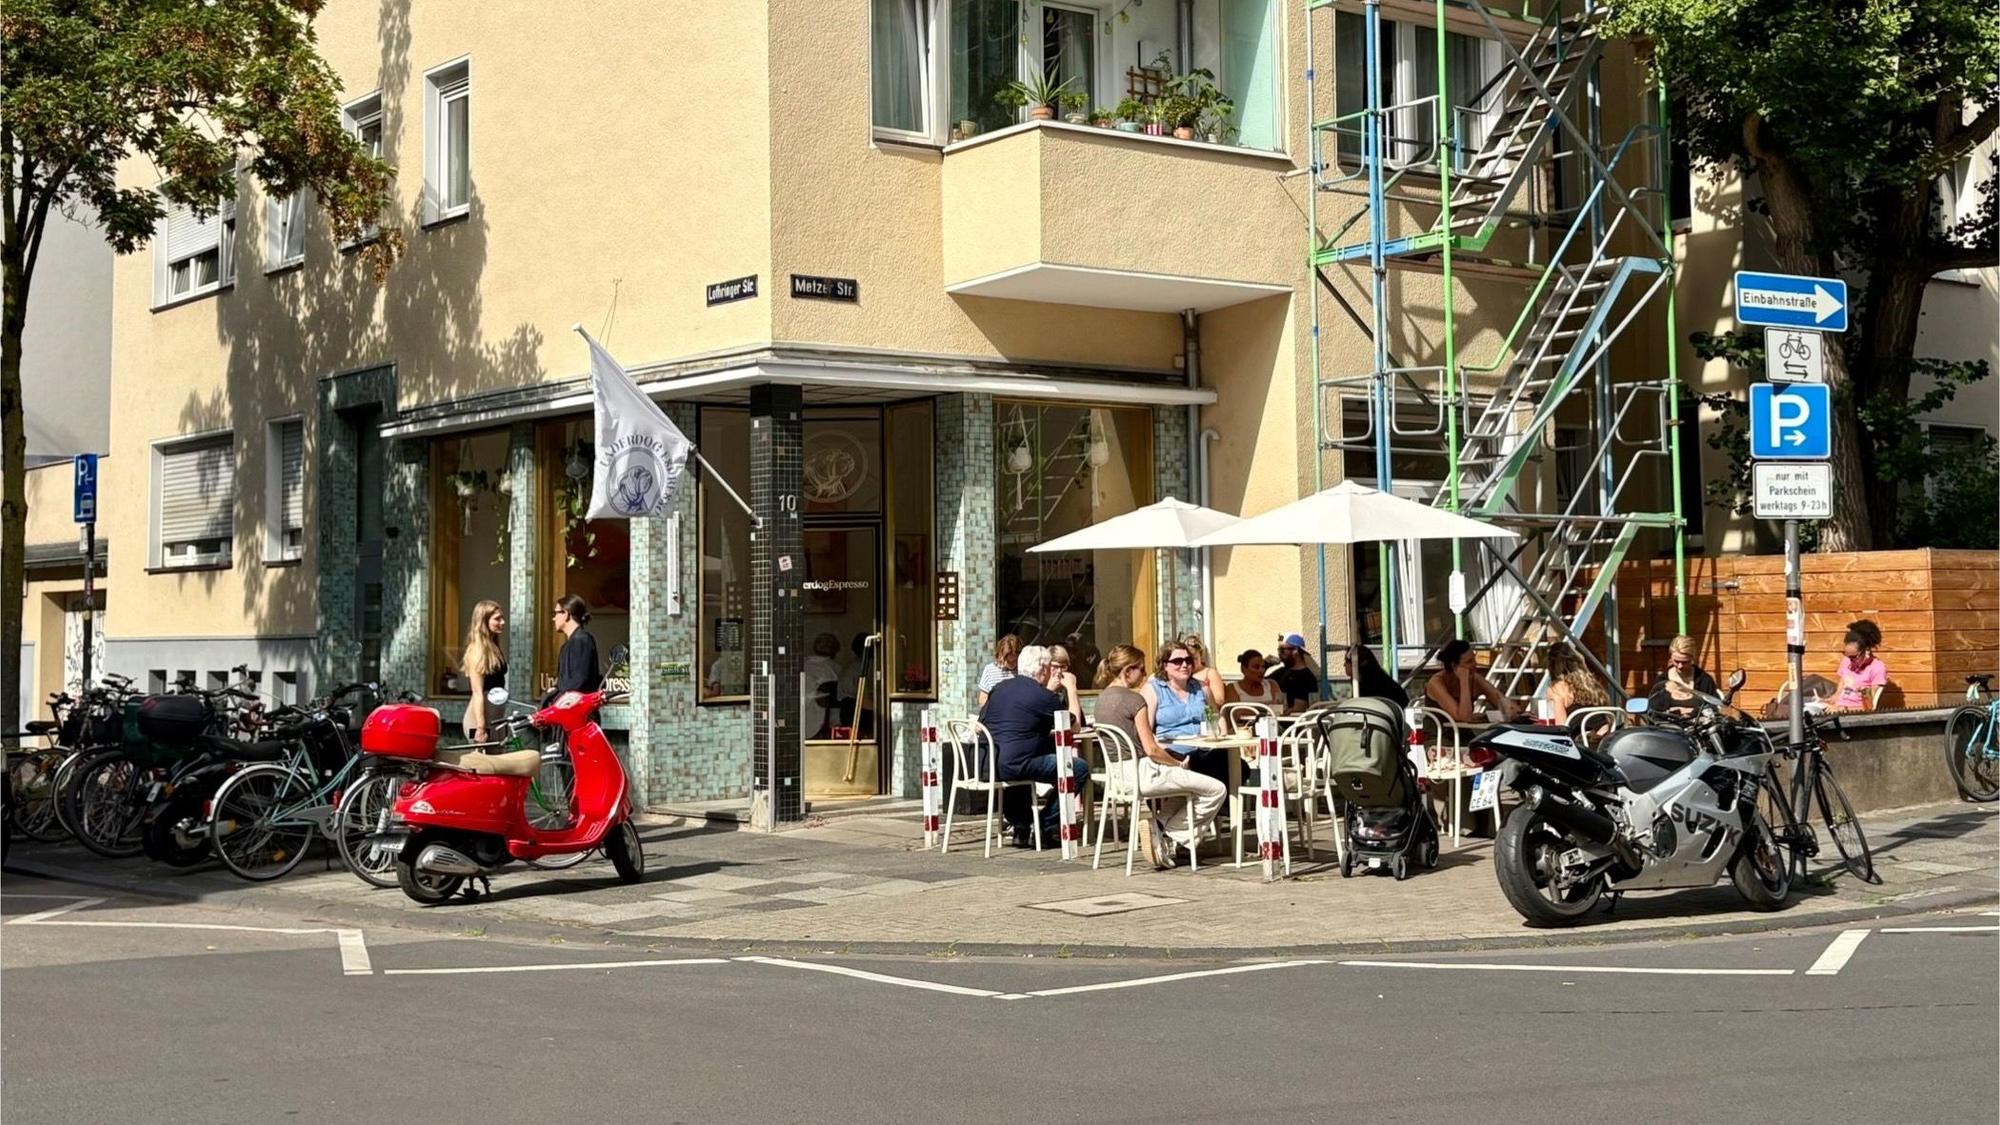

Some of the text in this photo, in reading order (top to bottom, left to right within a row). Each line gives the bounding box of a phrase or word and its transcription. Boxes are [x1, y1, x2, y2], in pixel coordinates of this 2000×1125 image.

[795, 278, 855, 296] Metze Str.
[1743, 291, 1818, 308] Einbahnstraße
[1771, 394, 1810, 448] P
[1775, 471, 1809, 481] nur mit
[1769, 485, 1816, 496] Parkschein
[778, 494, 797, 512] 10
[1760, 500, 1798, 513] werktags
[802, 579, 869, 592] erdogEspresso
